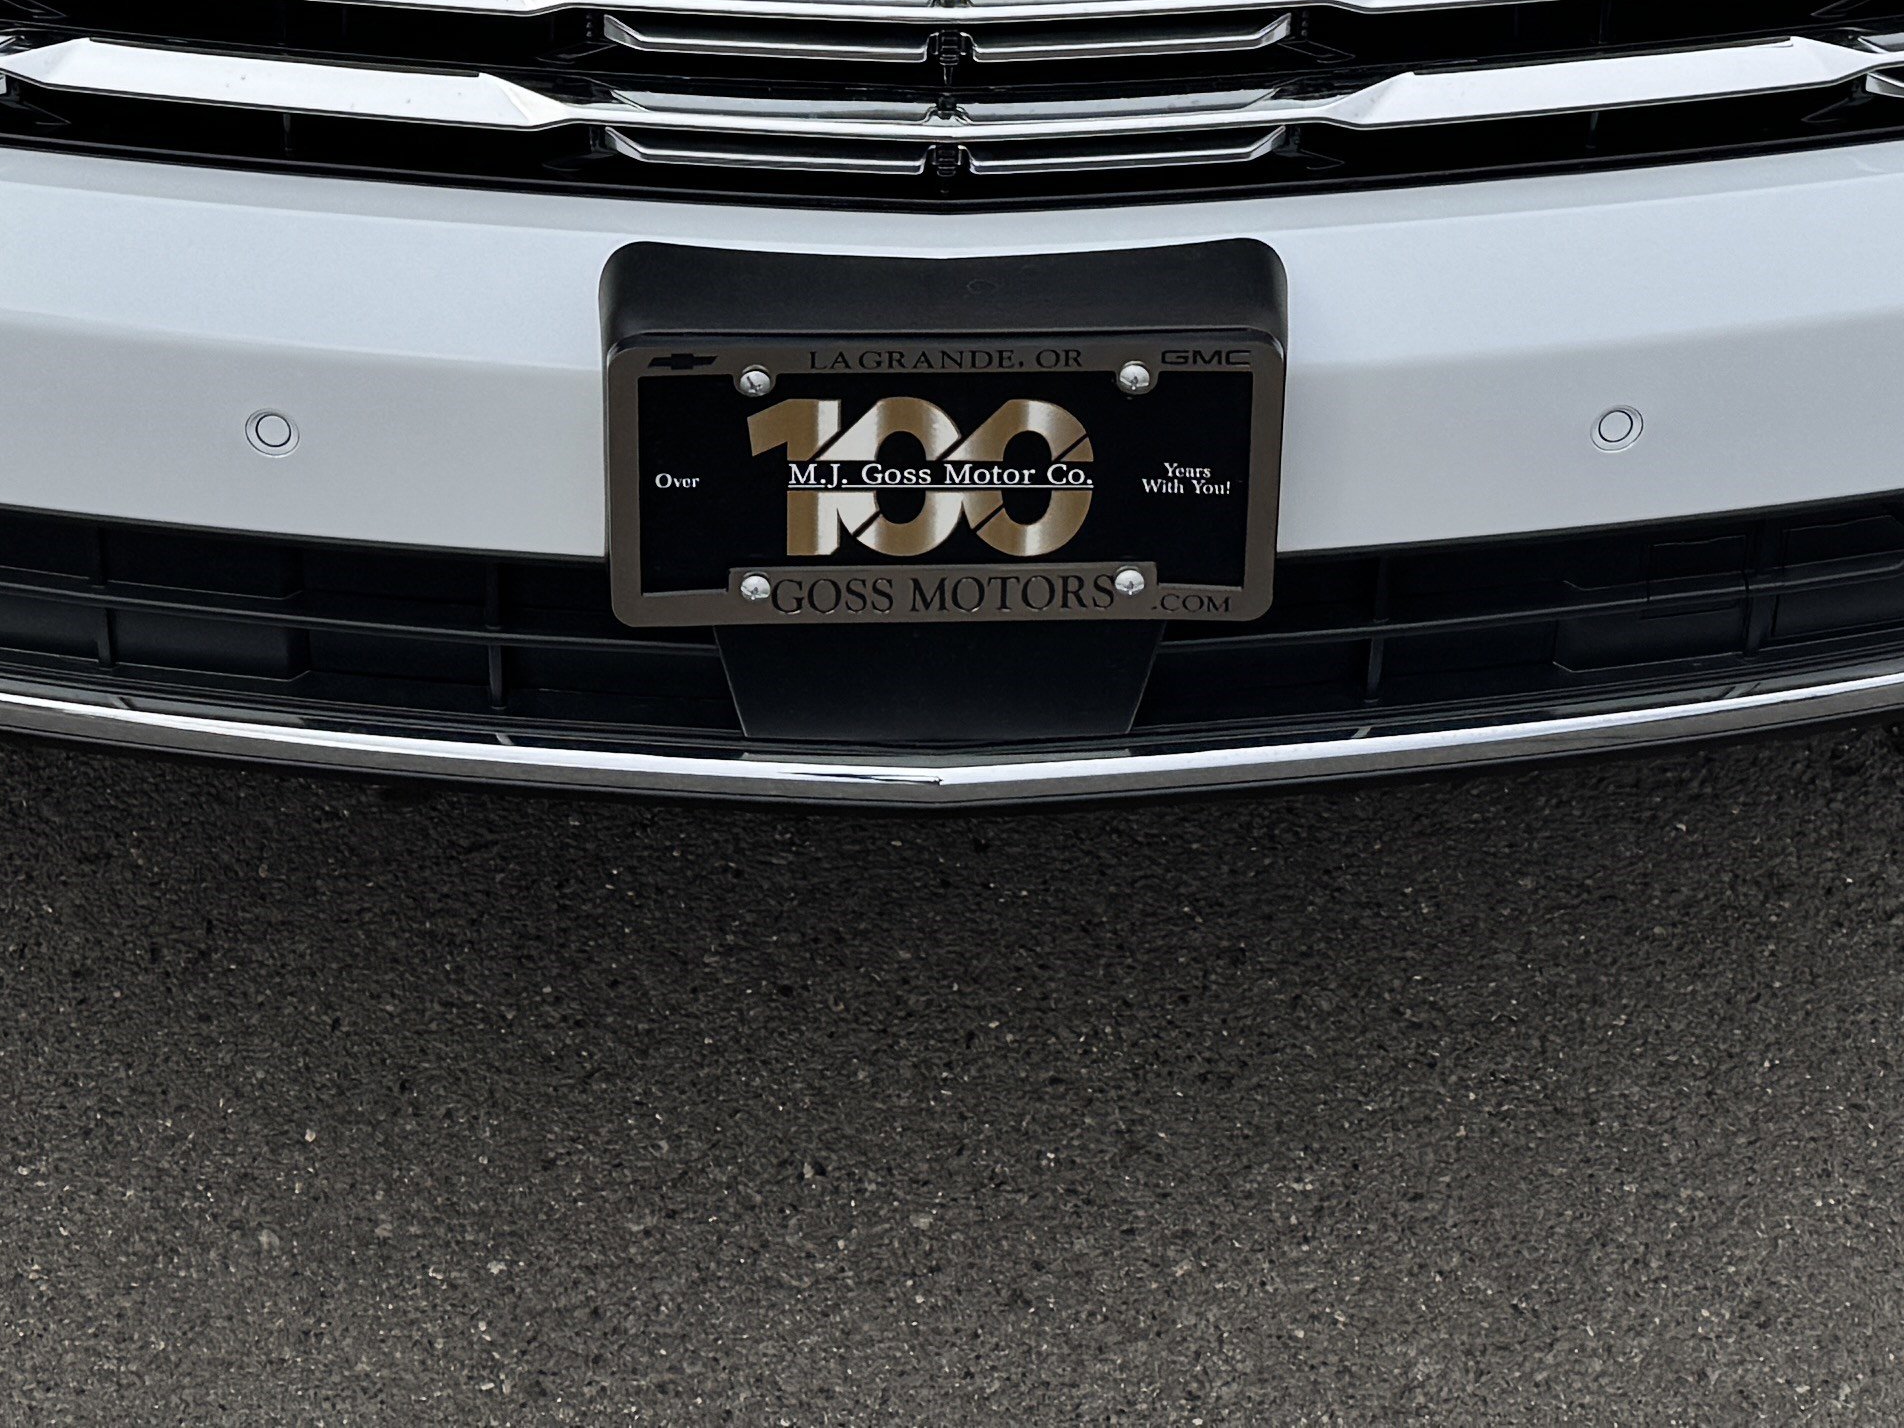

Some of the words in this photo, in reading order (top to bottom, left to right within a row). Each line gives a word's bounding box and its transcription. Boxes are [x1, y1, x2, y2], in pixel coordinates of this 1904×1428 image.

[1035, 348, 1083, 369] OR
[1160, 349, 1252, 366] GMC
[788, 463, 848, 489] M.J.
[861, 463, 932, 485] Goss
[943, 463, 1036, 485] Motor
[1046, 463, 1093, 486] Co.
[1163, 462, 1211, 478] Years
[654, 473, 700, 489] Over
[1141, 478, 1185, 495] With
[1192, 479, 1231, 495] You!
[770, 577, 894, 615] GOSS
[909, 574, 1115, 614] MOTORS
